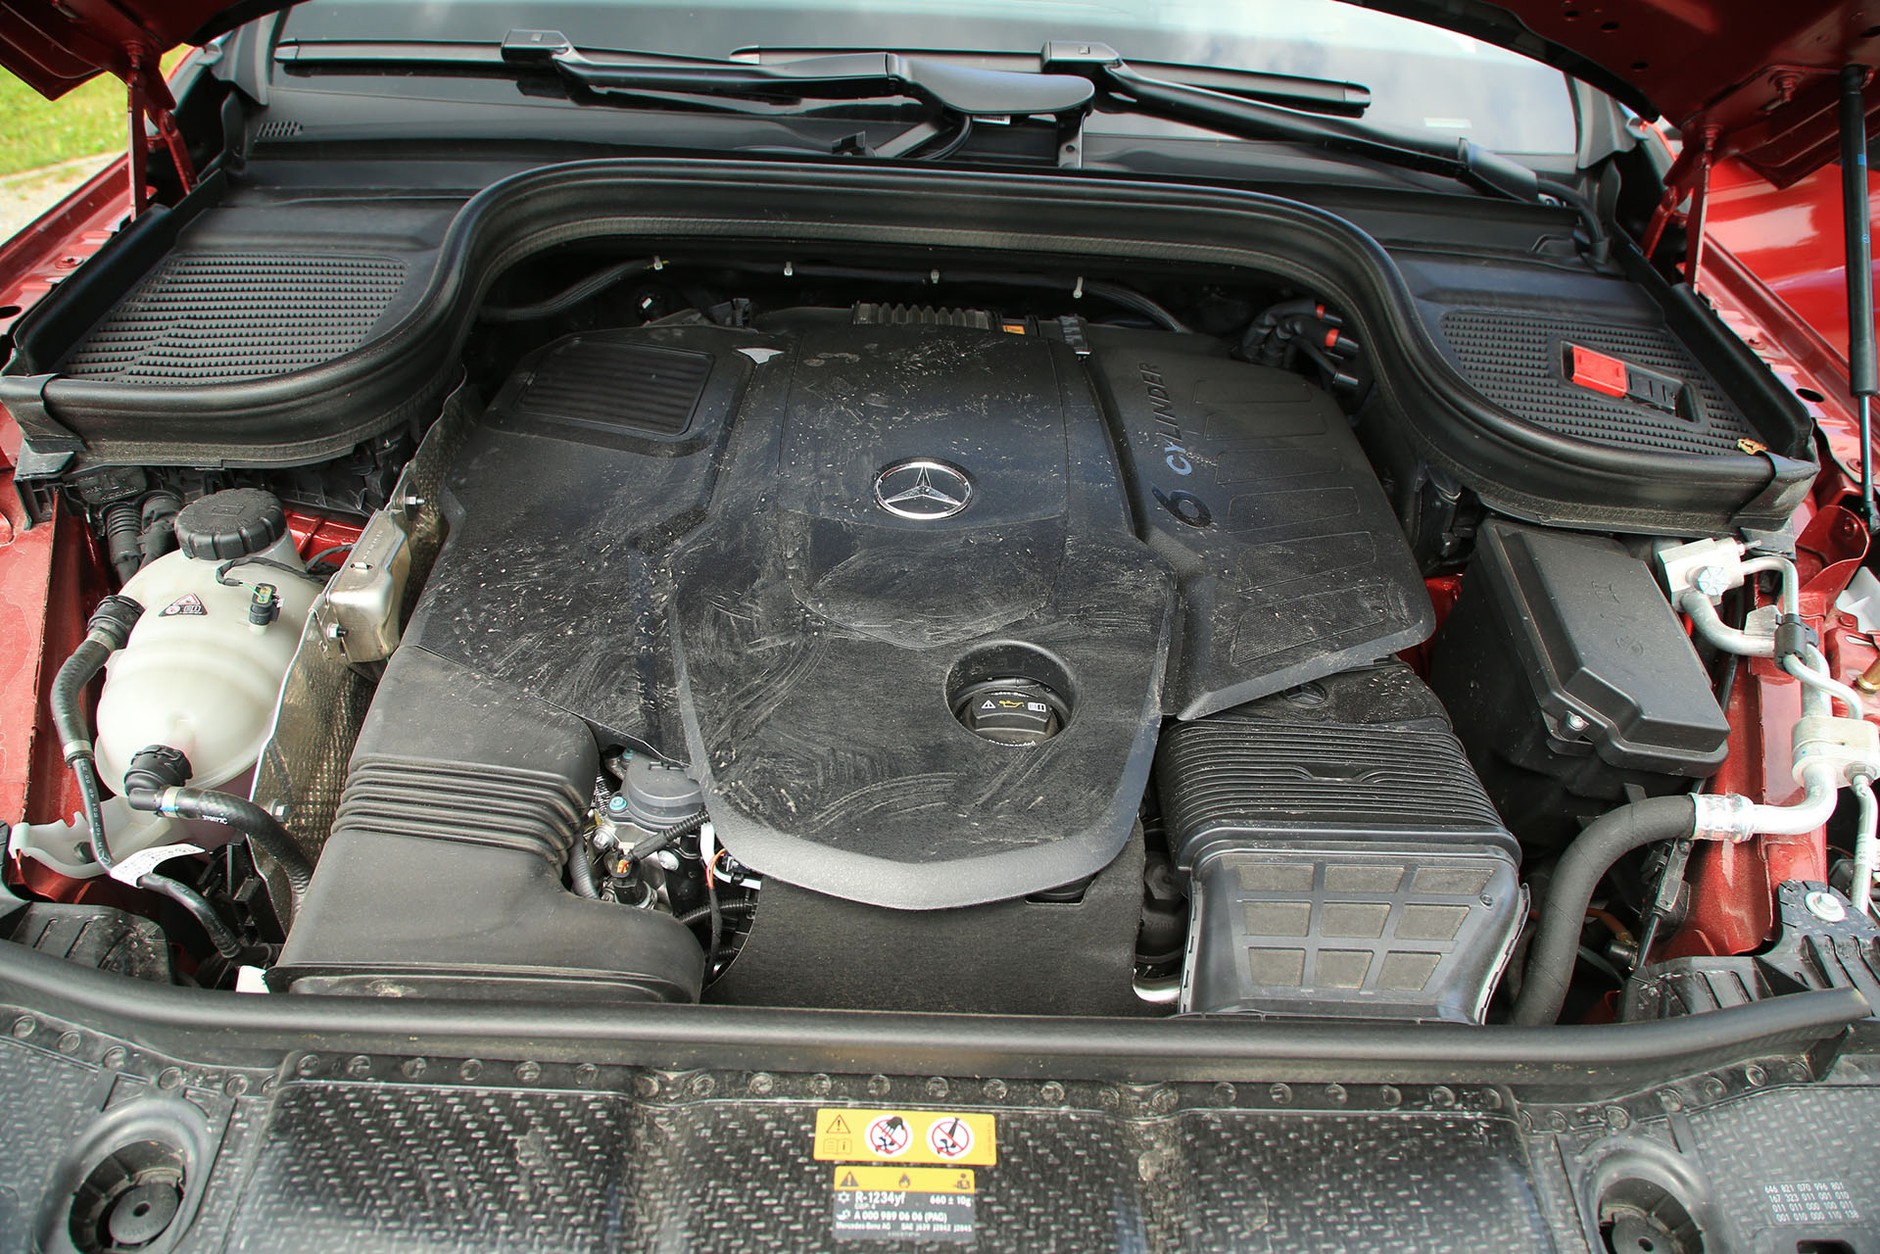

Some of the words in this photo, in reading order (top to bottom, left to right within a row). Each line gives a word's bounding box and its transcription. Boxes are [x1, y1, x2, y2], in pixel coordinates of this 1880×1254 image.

[1139, 362, 1192, 476] CYLINDER
[1151, 481, 1212, 529] 6
[1764, 1185, 1778, 1194] 646
[1780, 1184, 1795, 1193] 821
[1796, 1183, 1812, 1192] 070
[1813, 1183, 1828, 1191] 996
[1830, 1182, 1844, 1190] 801
[854, 1191, 906, 1208] R-1234yf
[930, 1195, 946, 1205] 660
[956, 1195, 972, 1207] 10g
[1768, 1194, 1781, 1203] 167
[1784, 1193, 1800, 1203] 323
[1801, 1193, 1815, 1202] 011
[1817, 1192, 1832, 1200] 001
[1835, 1191, 1850, 1200] 010
[1772, 1204, 1786, 1213] 011
[1788, 1203, 1803, 1212] 011
[1805, 1202, 1820, 1210] 000
[1823, 1201, 1837, 1210] 100
[1839, 1200, 1854, 1209] 011
[853, 1210, 861, 1220] A
[862, 1210, 879, 1220] 000
[881, 1210, 897, 1221] 989
[898, 1211, 910, 1221] 06
[911, 1211, 923, 1221] 06
[924, 1211, 947, 1223] (PAG)
[1775, 1213, 1790, 1222] 001
[1793, 1212, 1808, 1221] 010
[1810, 1211, 1825, 1220] 000
[1828, 1211, 1842, 1219] 110
[836, 1221, 880, 1230] Mercedes-Benz
[882, 1222, 891, 1230] AG
